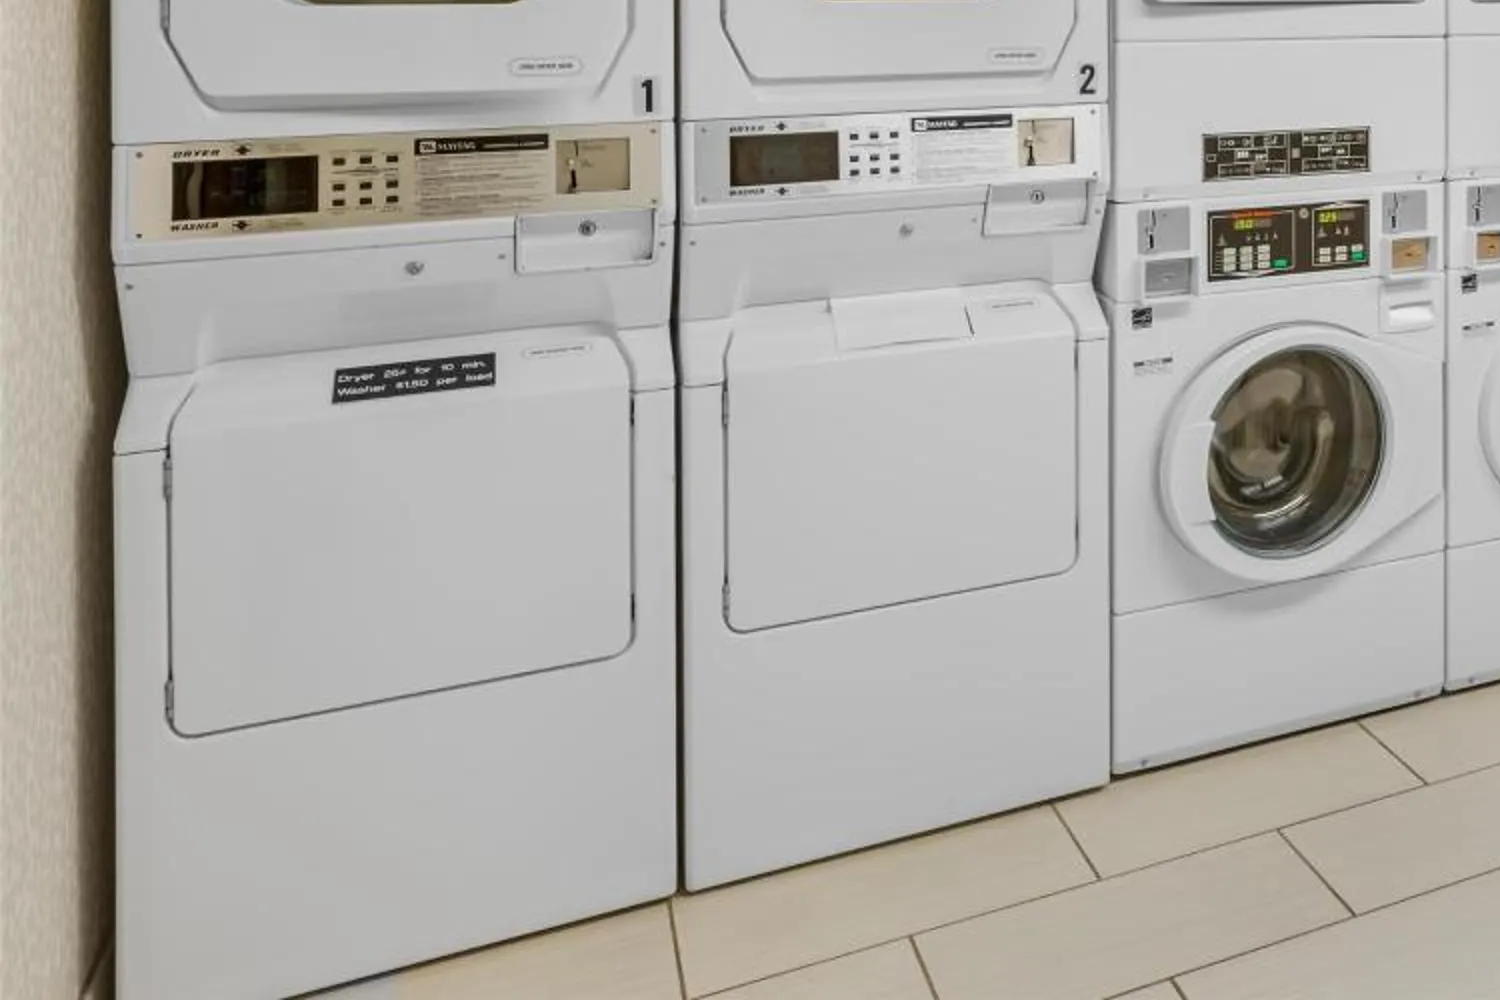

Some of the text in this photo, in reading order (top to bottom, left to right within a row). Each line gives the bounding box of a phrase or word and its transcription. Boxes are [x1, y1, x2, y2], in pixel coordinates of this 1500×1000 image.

[1079, 64, 1096, 95] 2
[641, 79, 653, 113] 1
[170, 221, 220, 233] WASHER
[337, 372, 376, 384] Dryer
[414, 366, 432, 375] for
[336, 384, 386, 397] Washer
[436, 376, 458, 387] per
